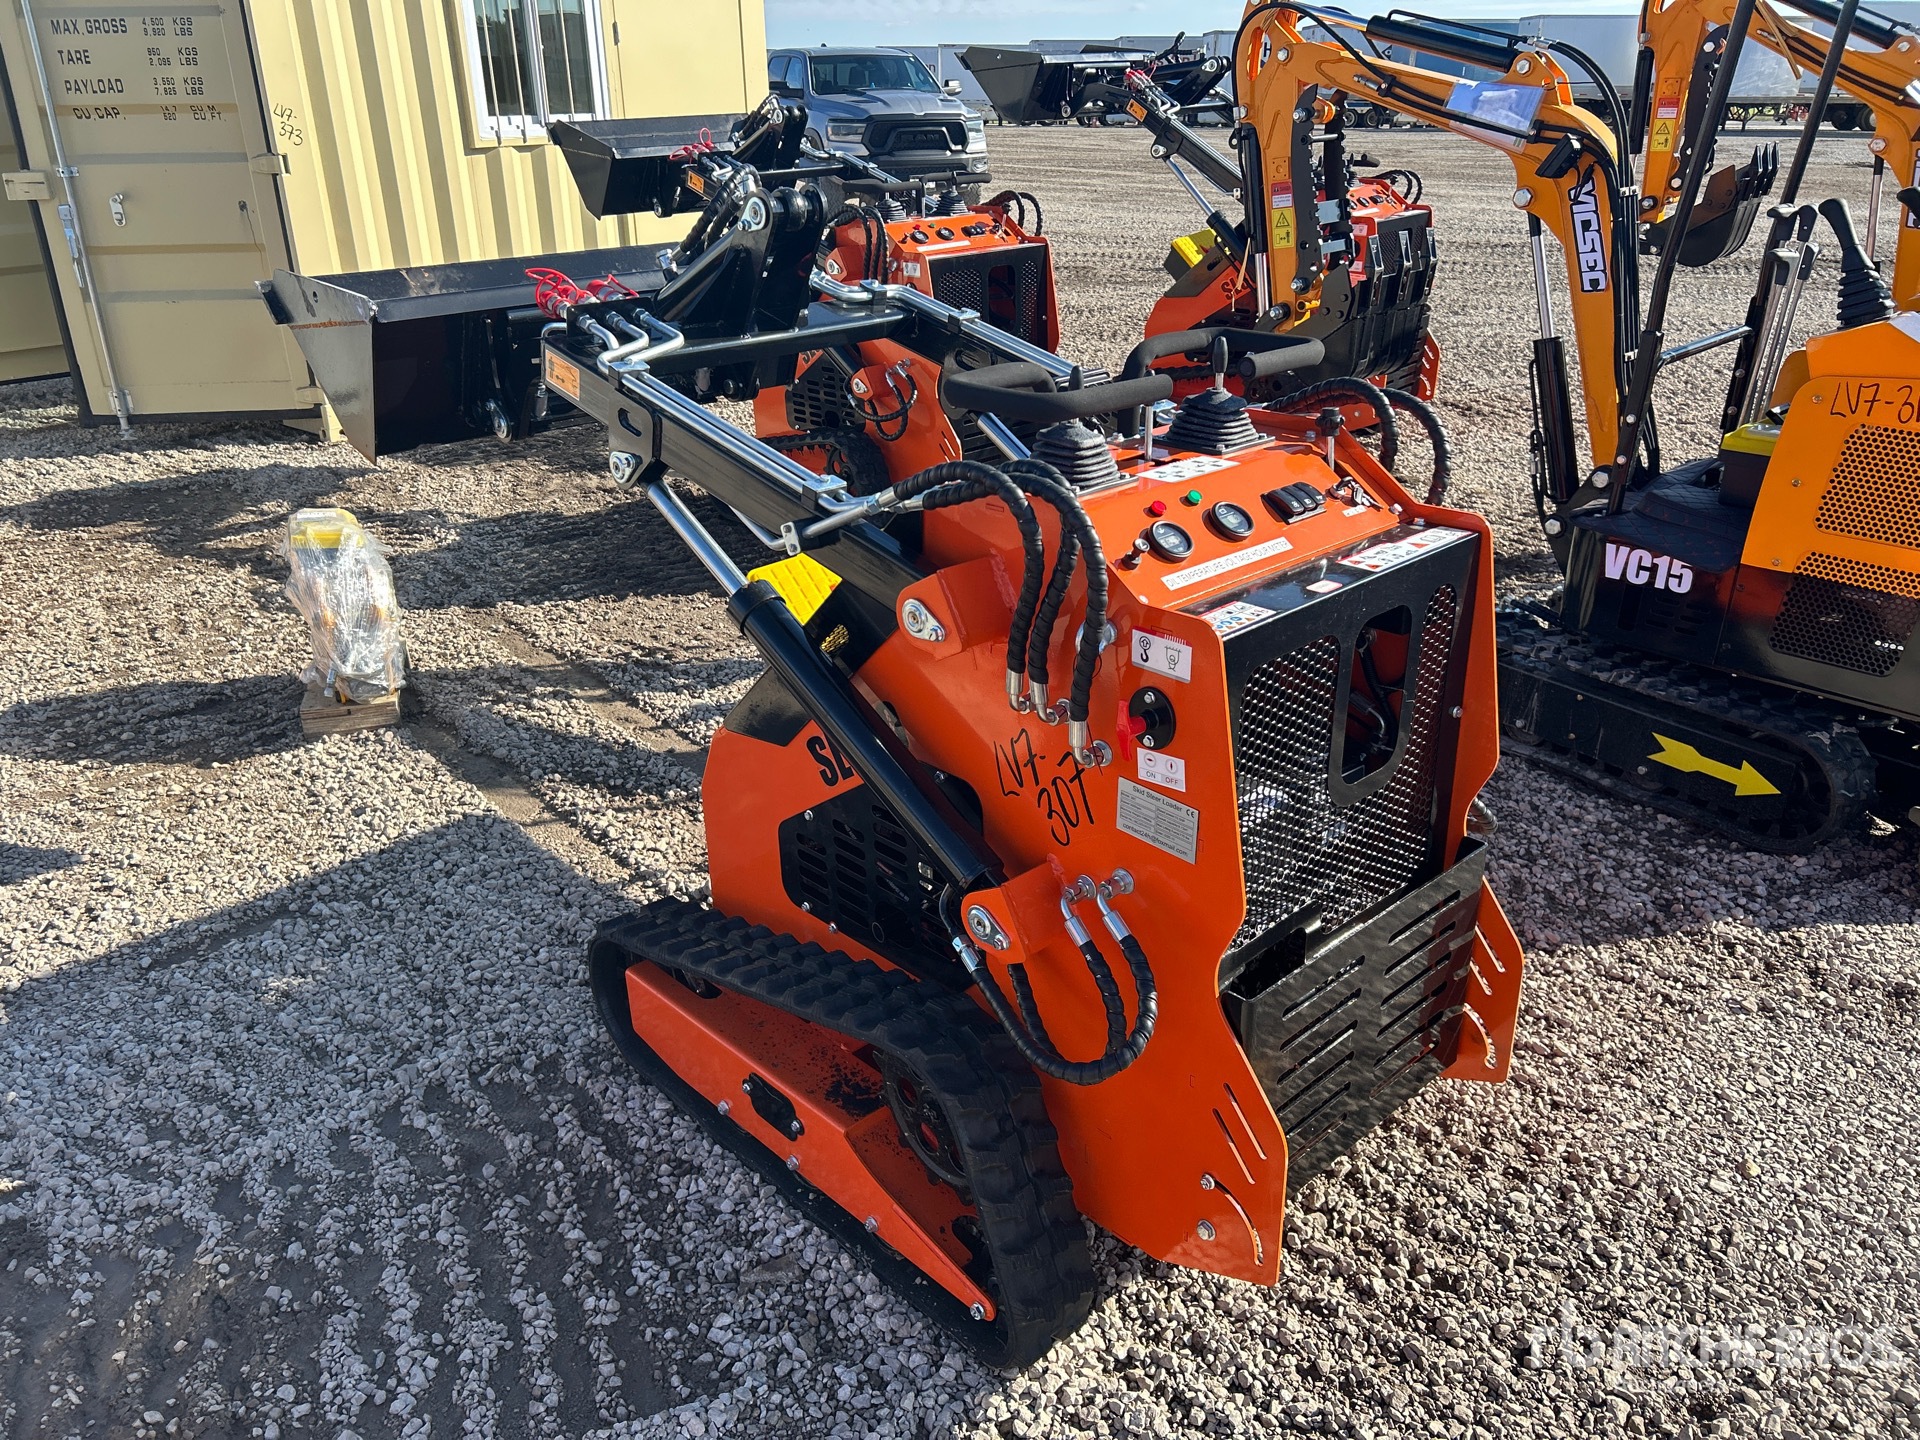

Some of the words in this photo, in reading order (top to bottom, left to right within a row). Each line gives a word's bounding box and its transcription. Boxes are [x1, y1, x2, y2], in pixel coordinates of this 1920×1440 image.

[172, 17, 193, 26] KGS
[173, 27, 193, 36] LBS
[57, 48, 91, 65] TARE
[177, 47, 198, 56] KGS
[178, 57, 199, 66] LBS
[182, 76, 204, 86] KGS
[64, 78, 124, 95] PAYLOAD
[184, 86, 204, 96] LBS
[162, 112, 177, 121] 520
[279, 121, 303, 146] 373
[1604, 542, 1694, 594] VC15
[1145, 770, 1156, 779] ON
[1165, 776, 1179, 786] OFF
[1037, 750, 1095, 847] 307
[1132, 785, 1145, 796] Skid
[1146, 791, 1161, 803] Steer
[1162, 798, 1183, 812] Loader
